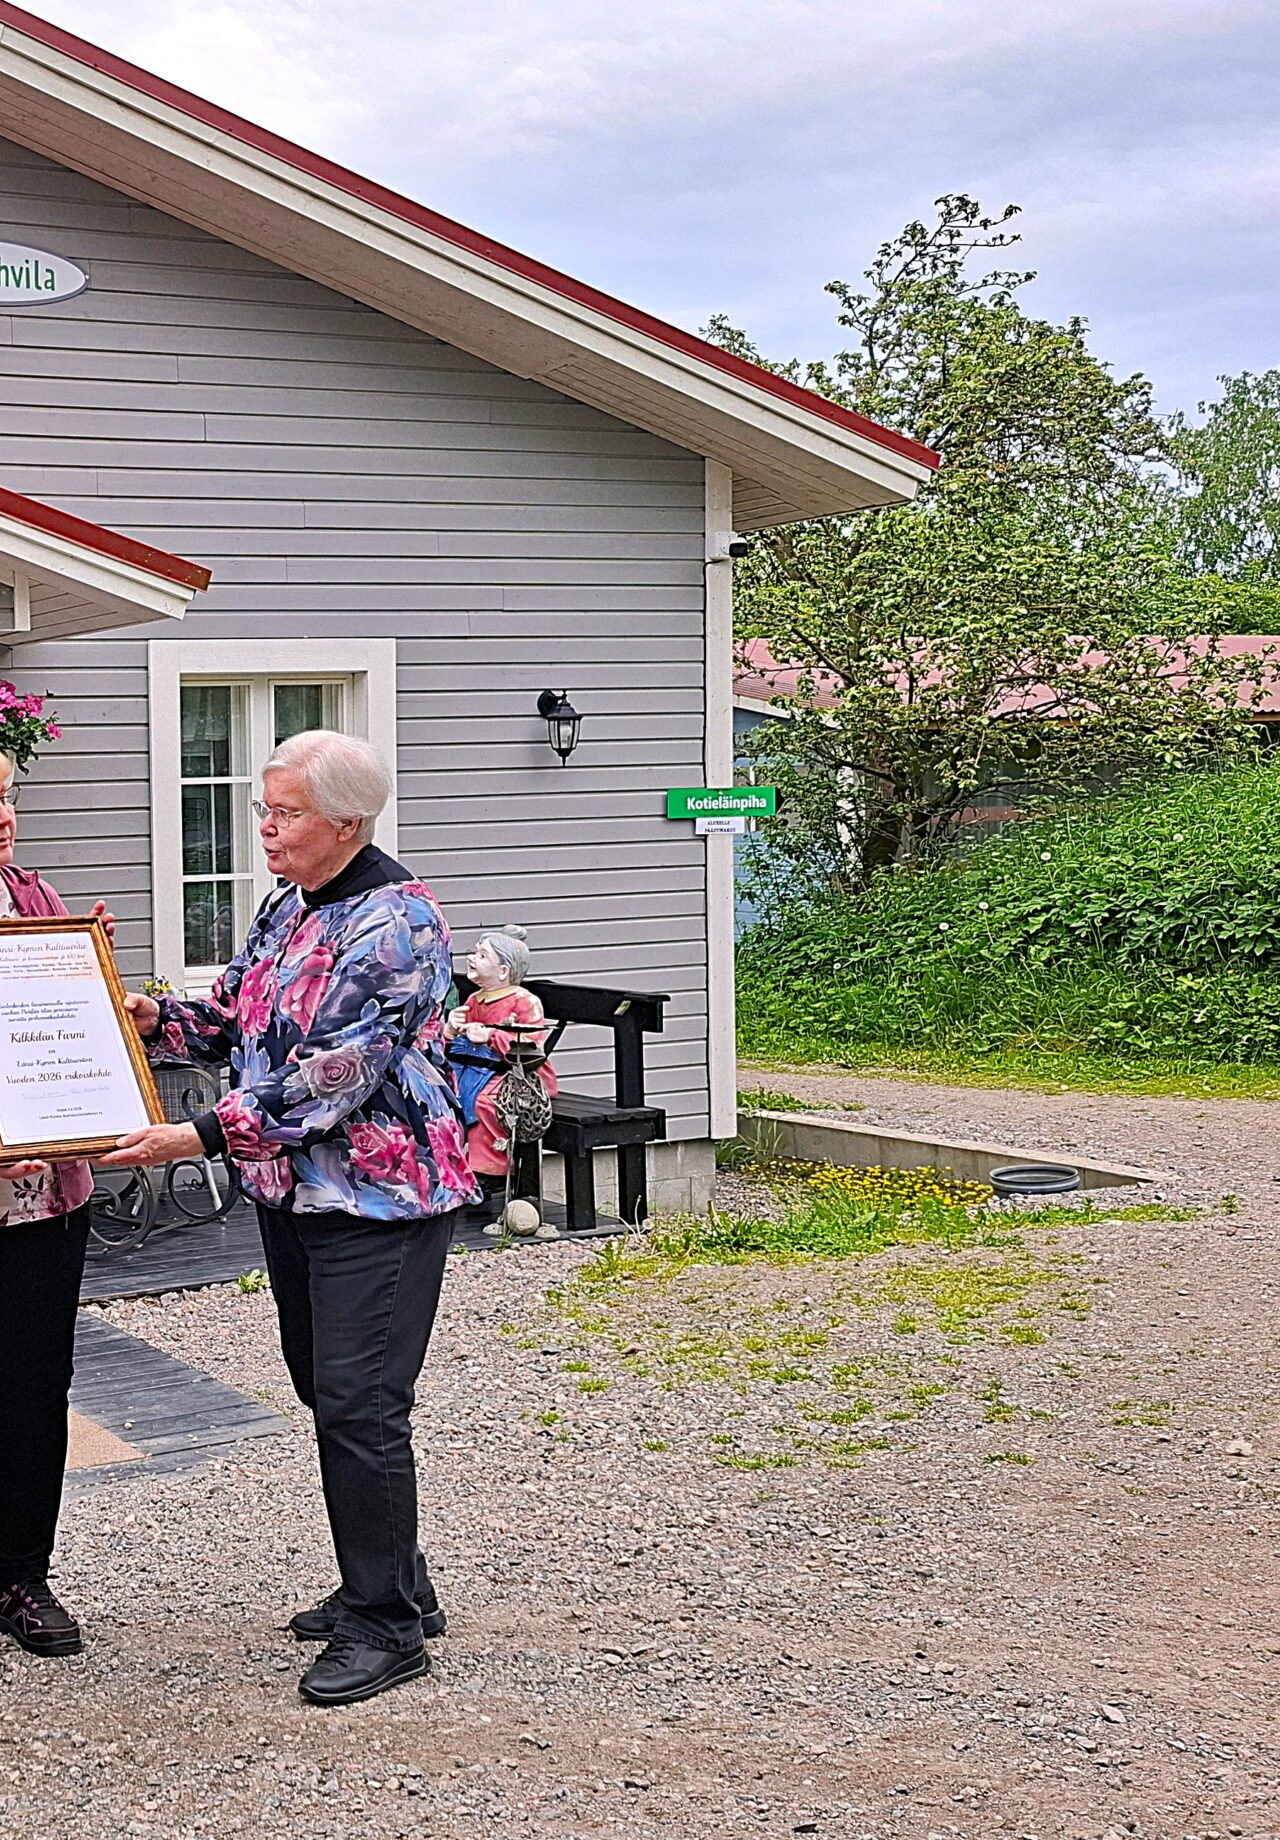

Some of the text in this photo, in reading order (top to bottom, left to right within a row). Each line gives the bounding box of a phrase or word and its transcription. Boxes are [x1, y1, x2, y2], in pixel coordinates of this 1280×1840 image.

[687, 795, 767, 811] Kotieläinpiha
[9, 1029, 85, 1043] Kilkkilän Farmi
[6, 1068, 112, 1084] Vuoden 2026 erikoiskohde
